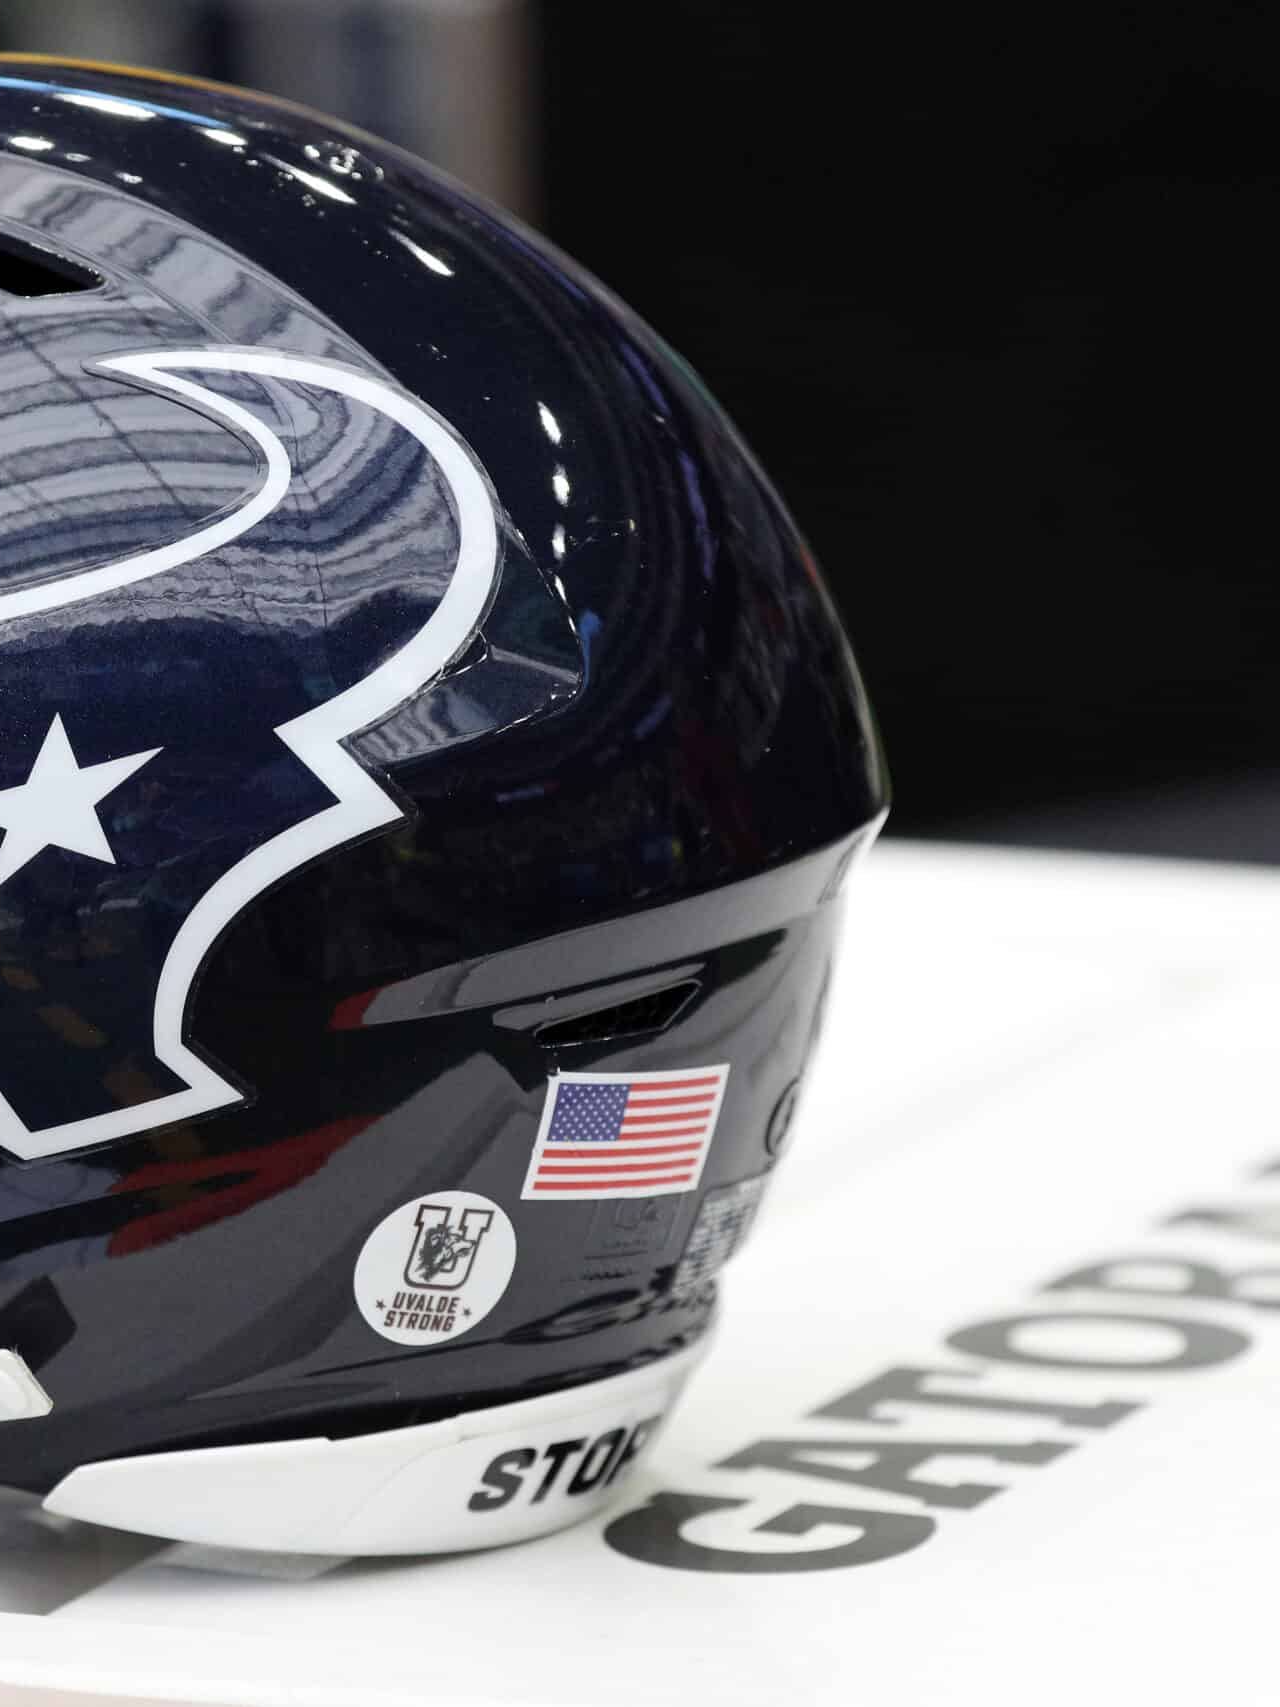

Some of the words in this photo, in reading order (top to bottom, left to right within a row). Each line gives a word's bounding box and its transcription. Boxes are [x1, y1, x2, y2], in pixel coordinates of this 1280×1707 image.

[403, 1203, 495, 1291] U
[383, 1310, 456, 1333] STRONG
[391, 1291, 461, 1314] UVALDE
[603, 1150, 1280, 1575] GATOR
